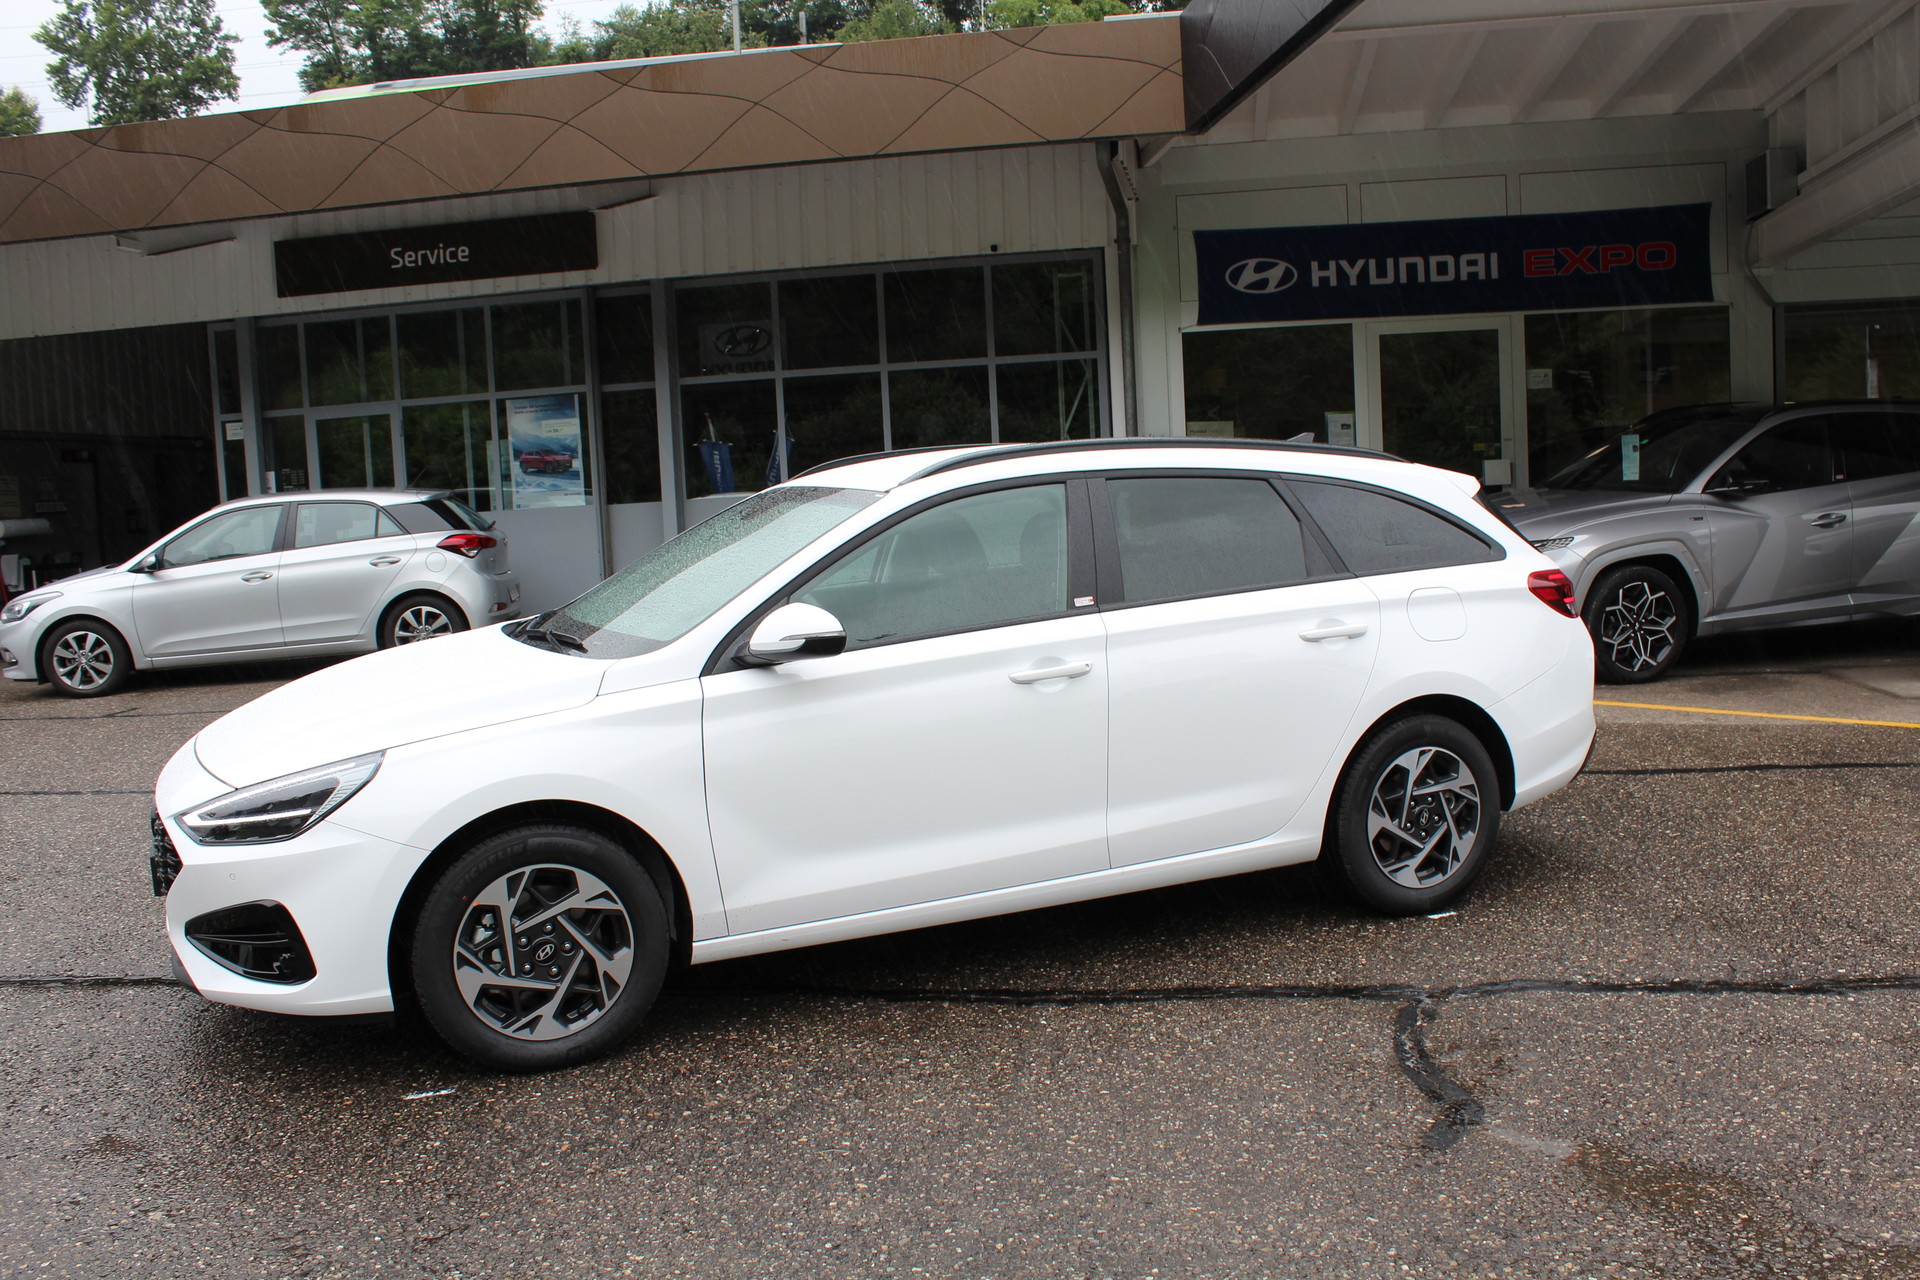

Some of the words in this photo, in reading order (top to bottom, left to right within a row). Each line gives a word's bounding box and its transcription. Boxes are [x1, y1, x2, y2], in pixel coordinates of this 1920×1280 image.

[390, 243, 469, 268] Service
[1310, 252, 1499, 287] HYUNDAI
[1523, 240, 1677, 278] EXPO
